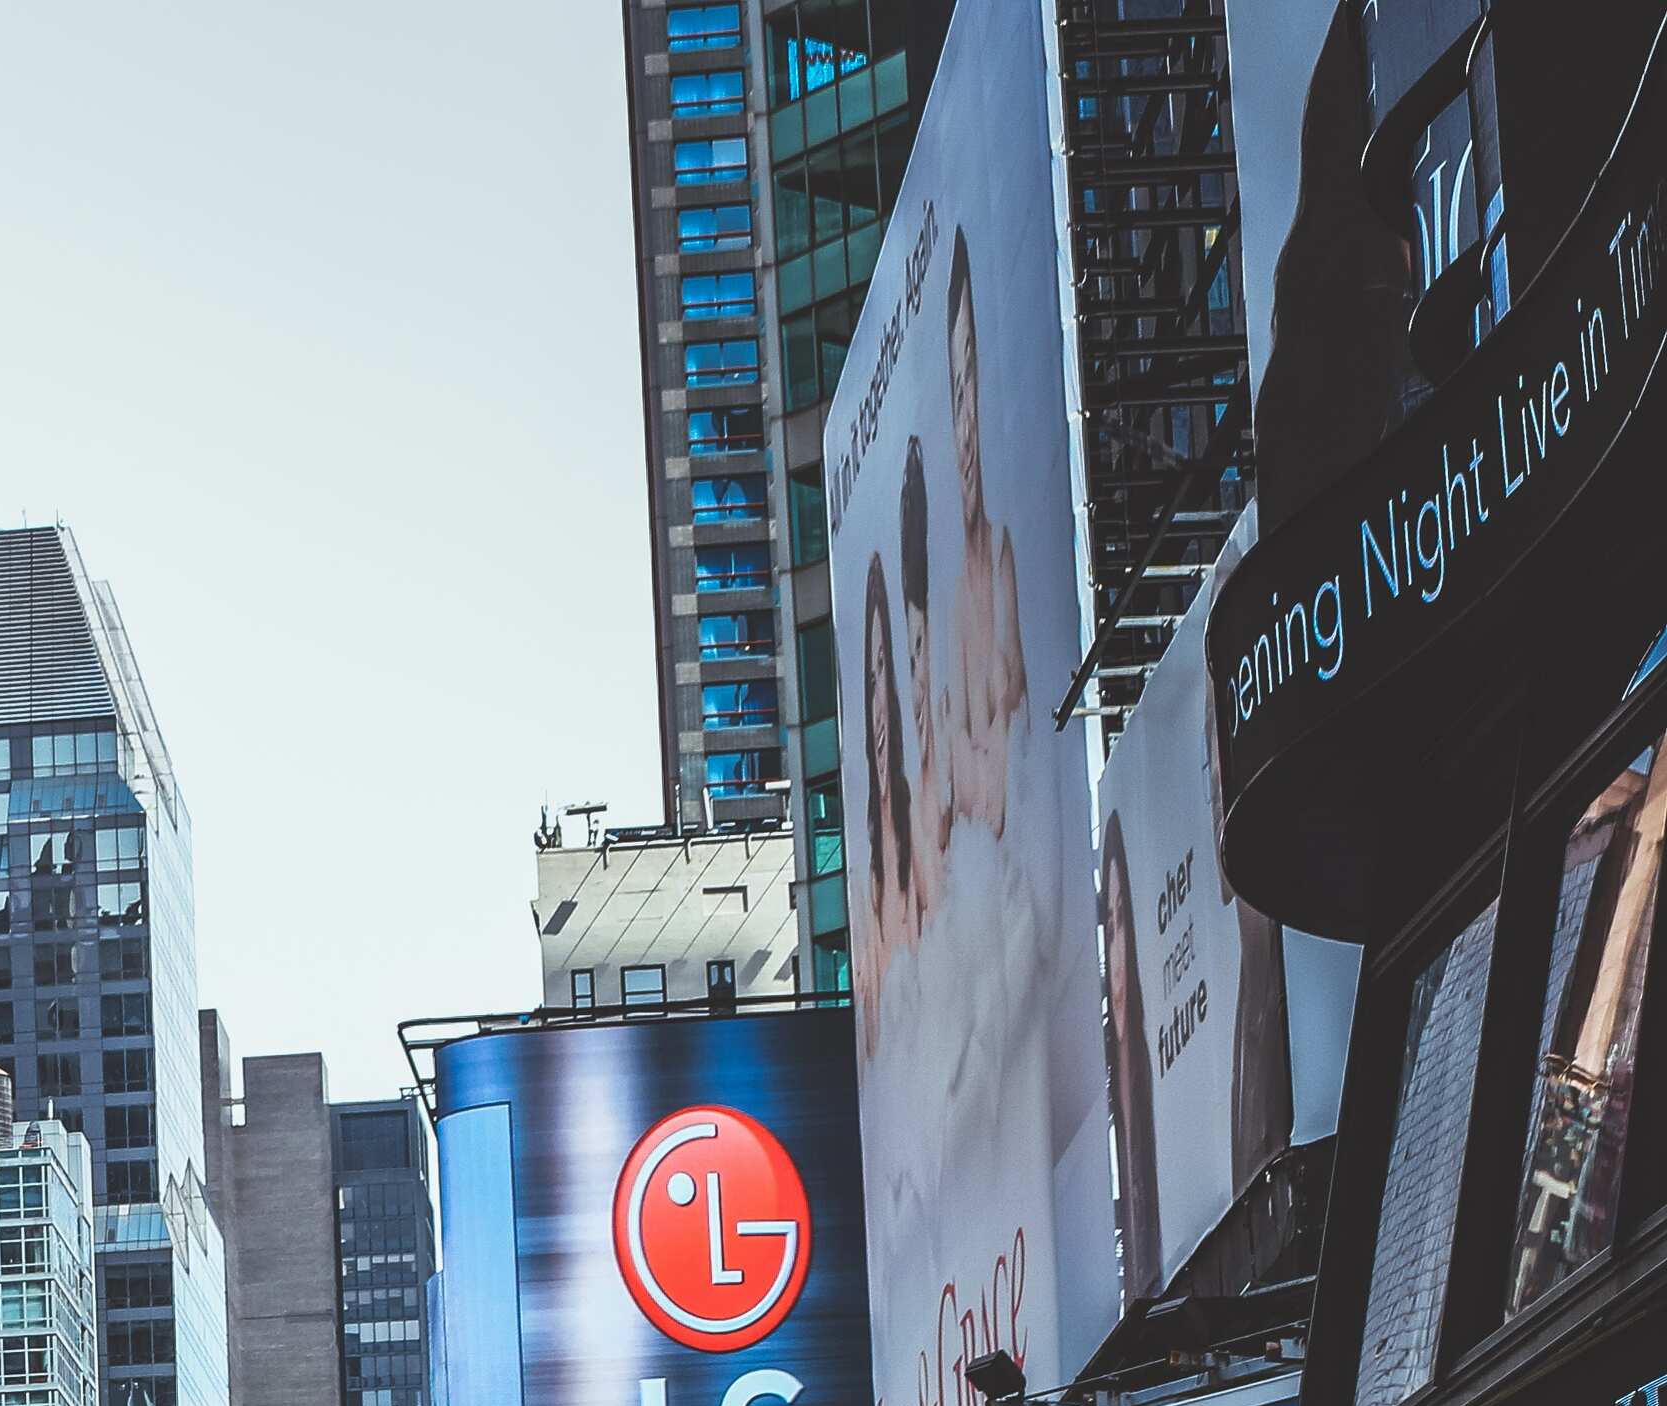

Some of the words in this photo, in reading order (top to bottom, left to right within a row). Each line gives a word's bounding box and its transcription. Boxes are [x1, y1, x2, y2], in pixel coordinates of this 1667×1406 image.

[1360, 439, 1489, 619] Night
[1496, 362, 1571, 498] Live
[1577, 299, 1609, 401] in
[1156, 846, 1195, 936] cher
[1160, 915, 1196, 1001] meet
[1158, 977, 1209, 1080] future
